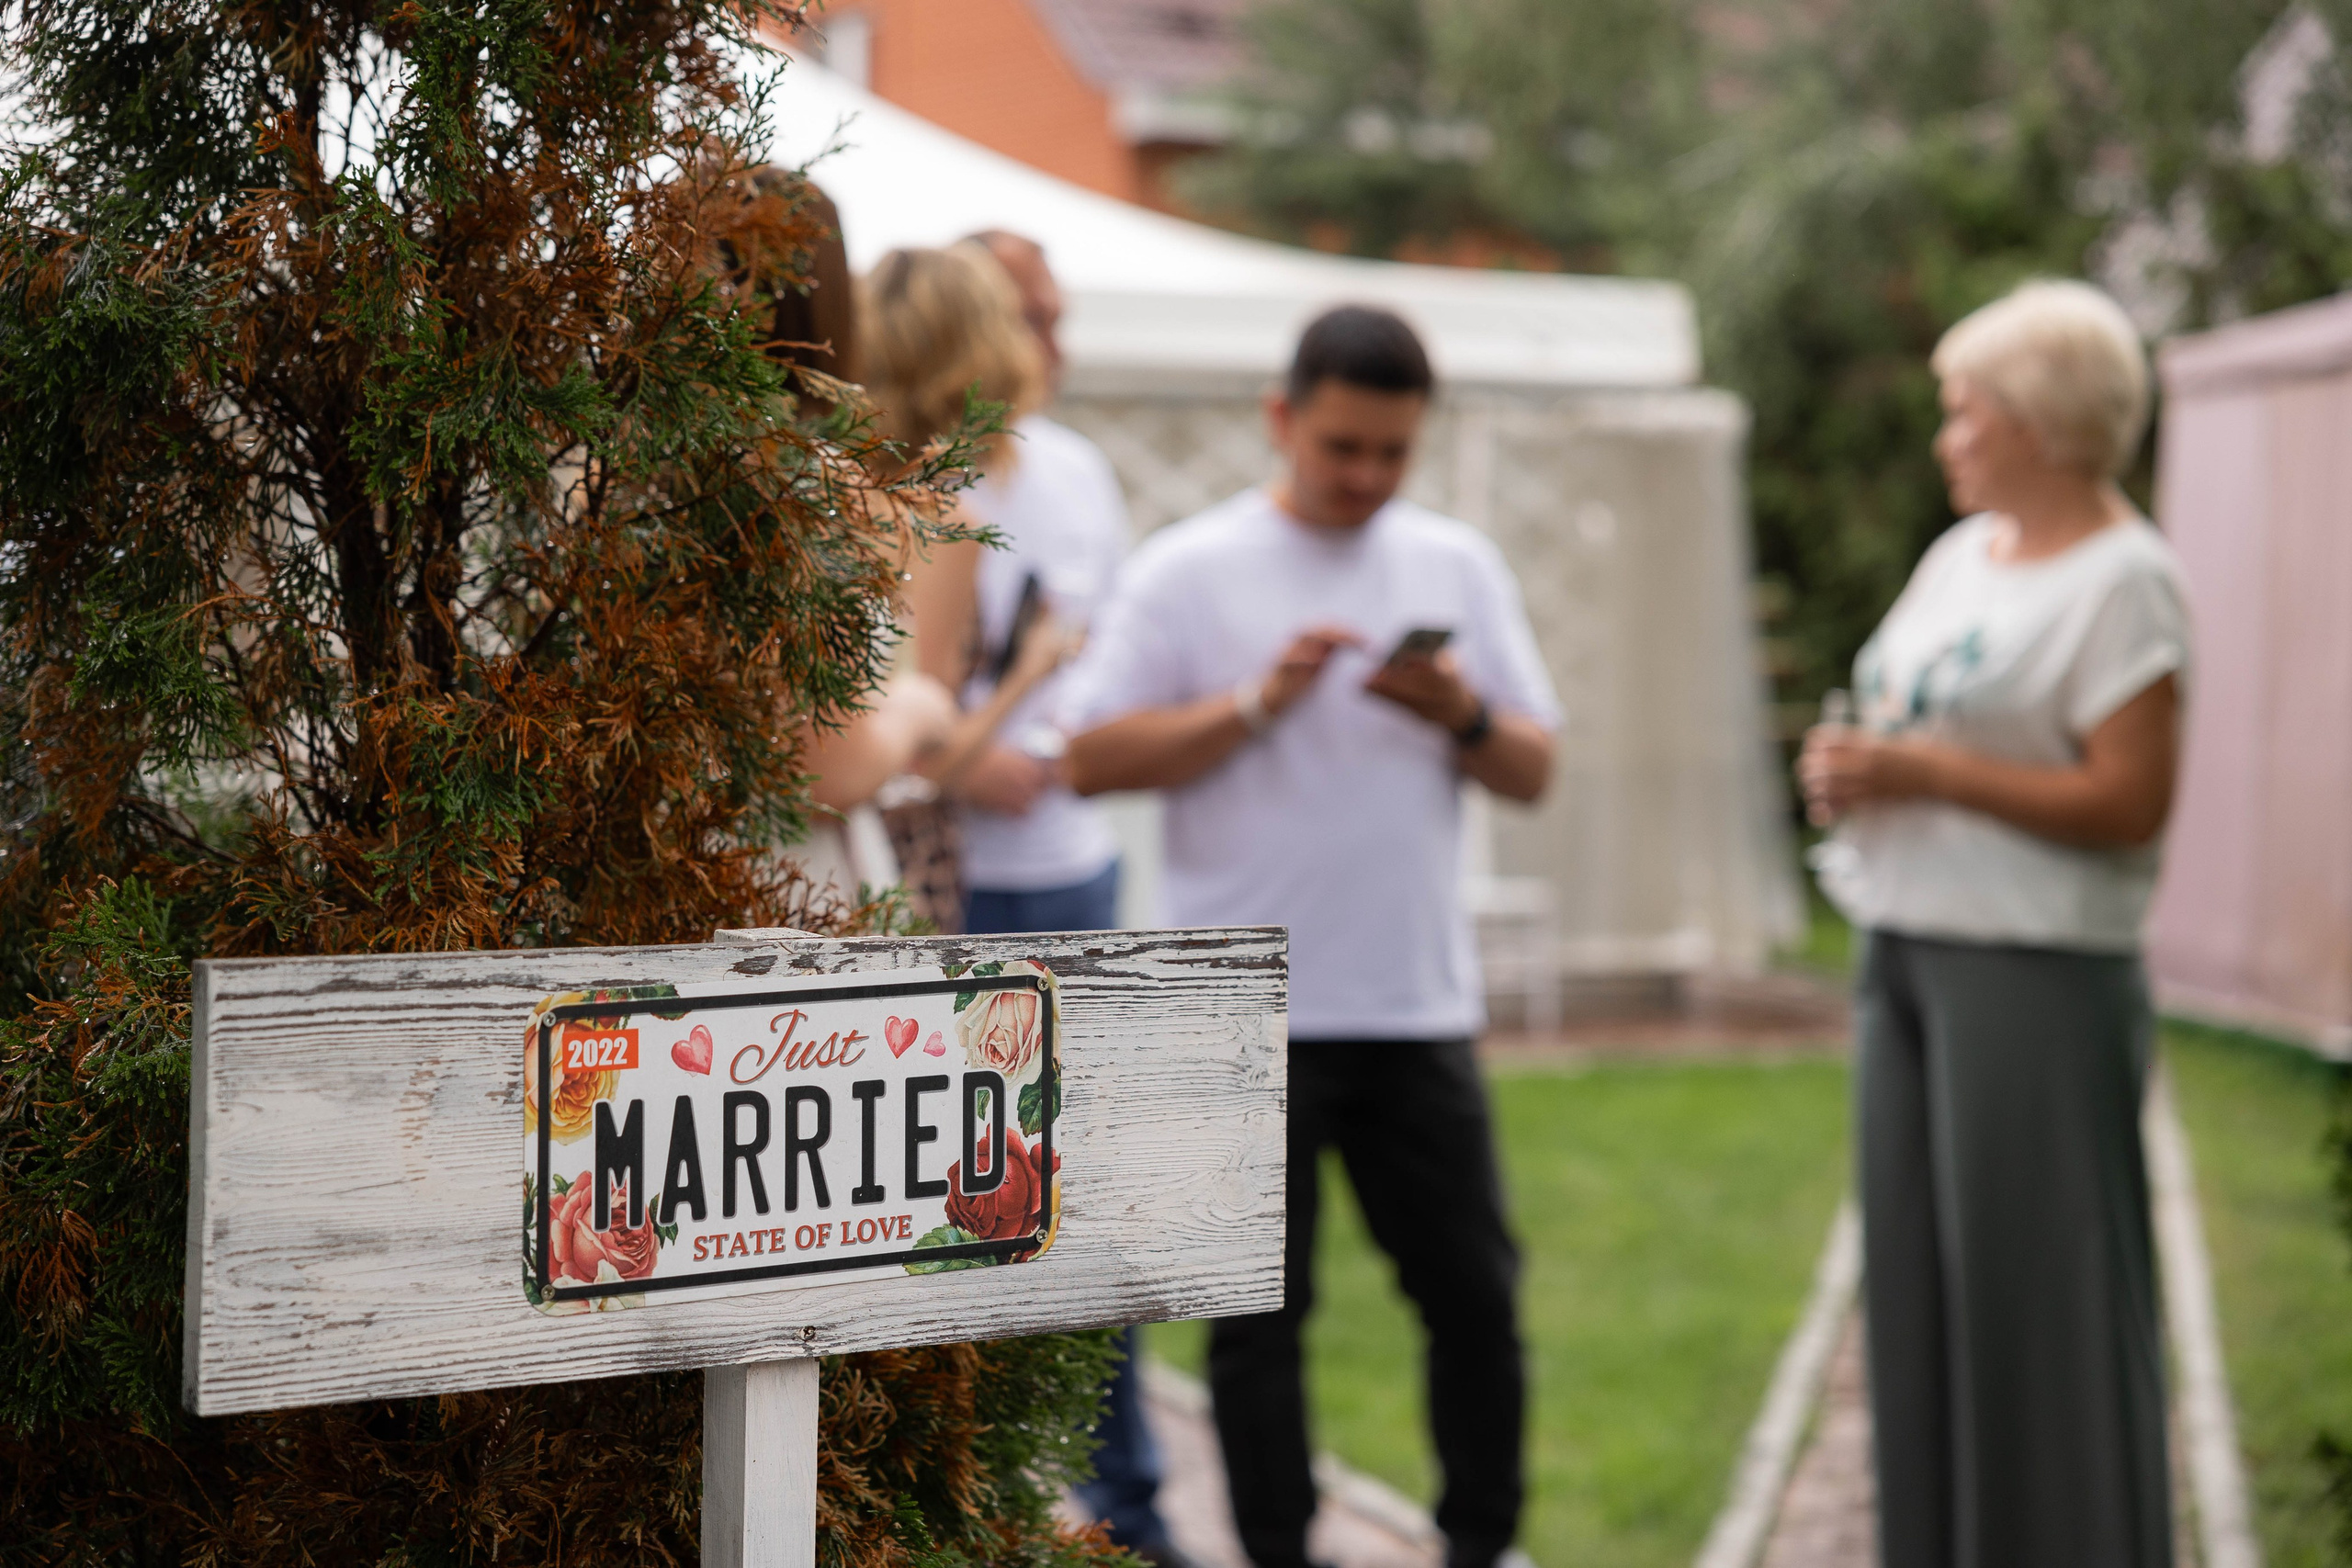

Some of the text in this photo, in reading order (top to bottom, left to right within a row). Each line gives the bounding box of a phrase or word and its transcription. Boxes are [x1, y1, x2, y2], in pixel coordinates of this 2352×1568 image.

[568, 1036, 628, 1069] 2022
[729, 1009, 869, 1085] Just
[594, 1070, 1008, 1232] MARRIED
[692, 1214, 914, 1261] STATE OF LOVE
